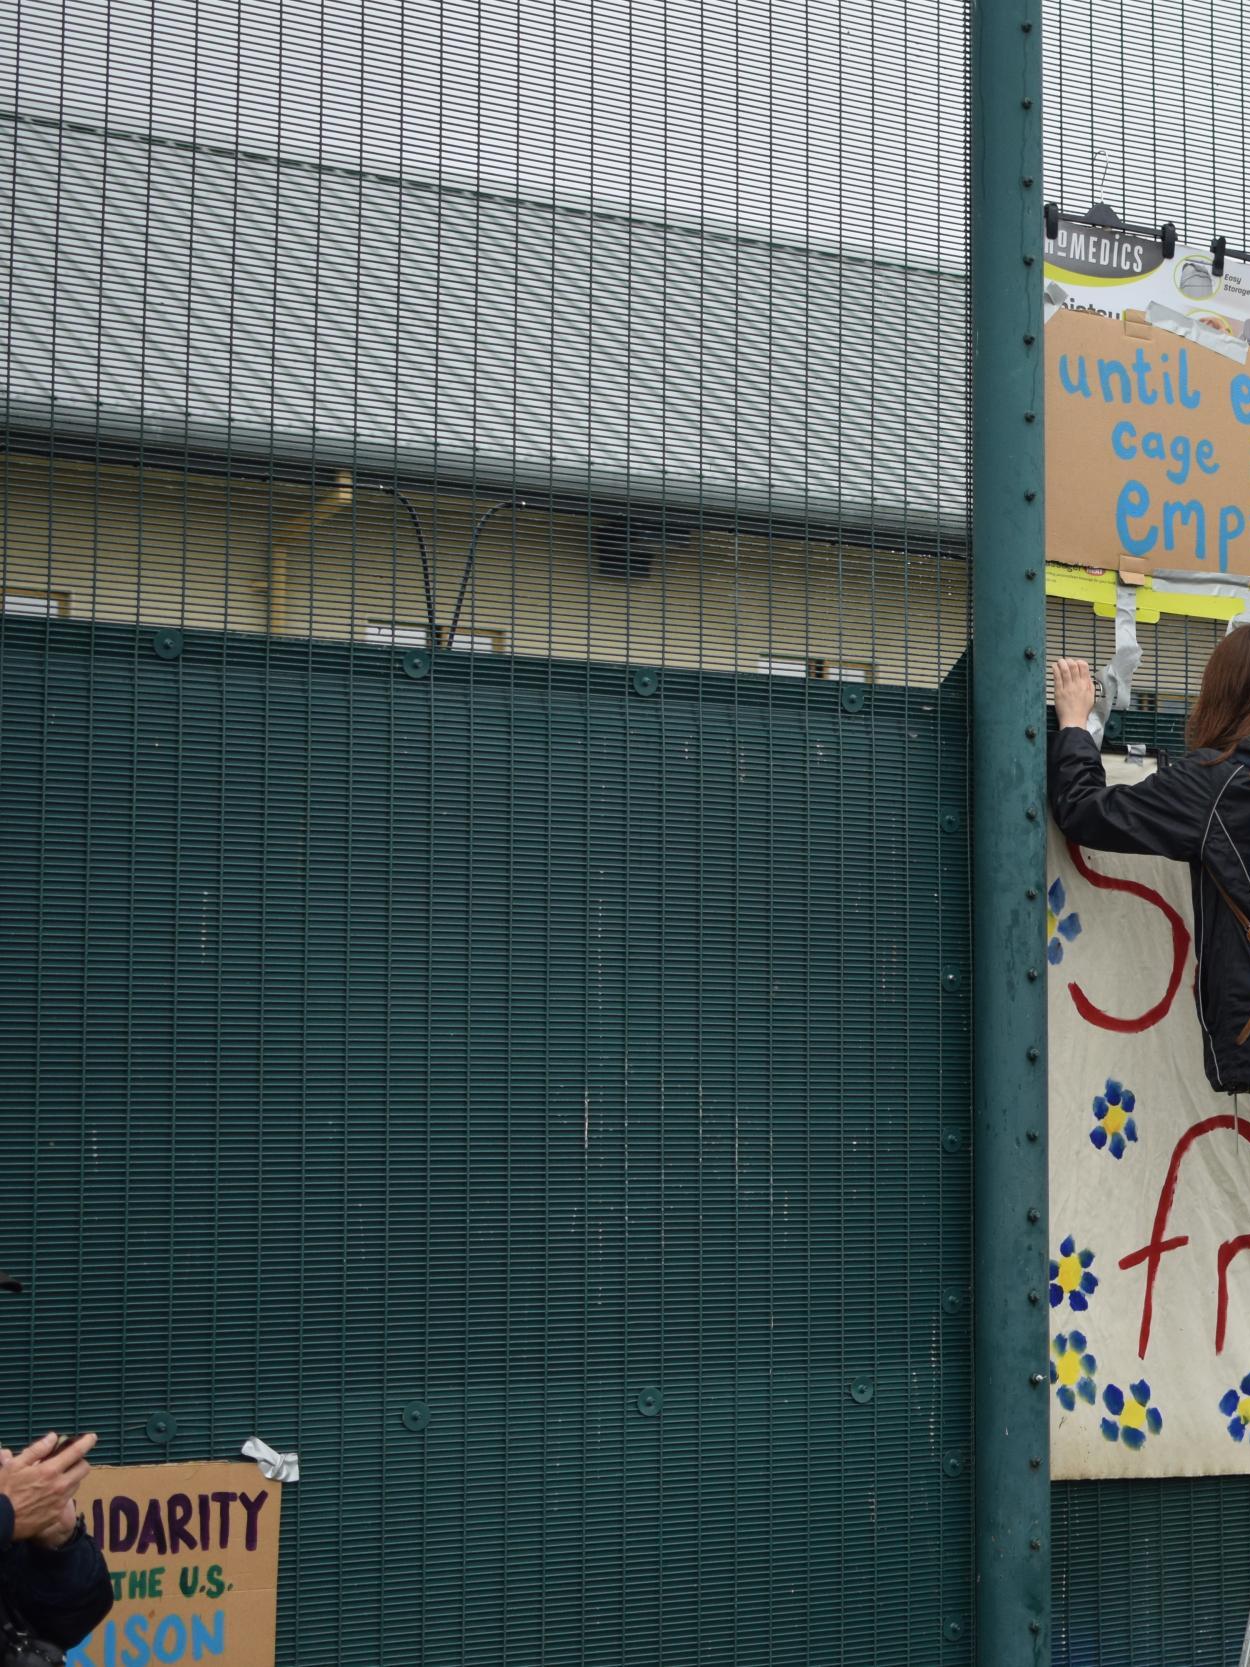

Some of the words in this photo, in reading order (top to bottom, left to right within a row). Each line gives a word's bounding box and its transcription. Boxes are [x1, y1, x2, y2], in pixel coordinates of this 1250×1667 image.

[1224, 273, 1242, 285] Easy
[1224, 284, 1250, 297] Storage
[1059, 348, 1201, 409] until
[1111, 420, 1219, 485] cage
[110, 1566, 166, 1601] THE
